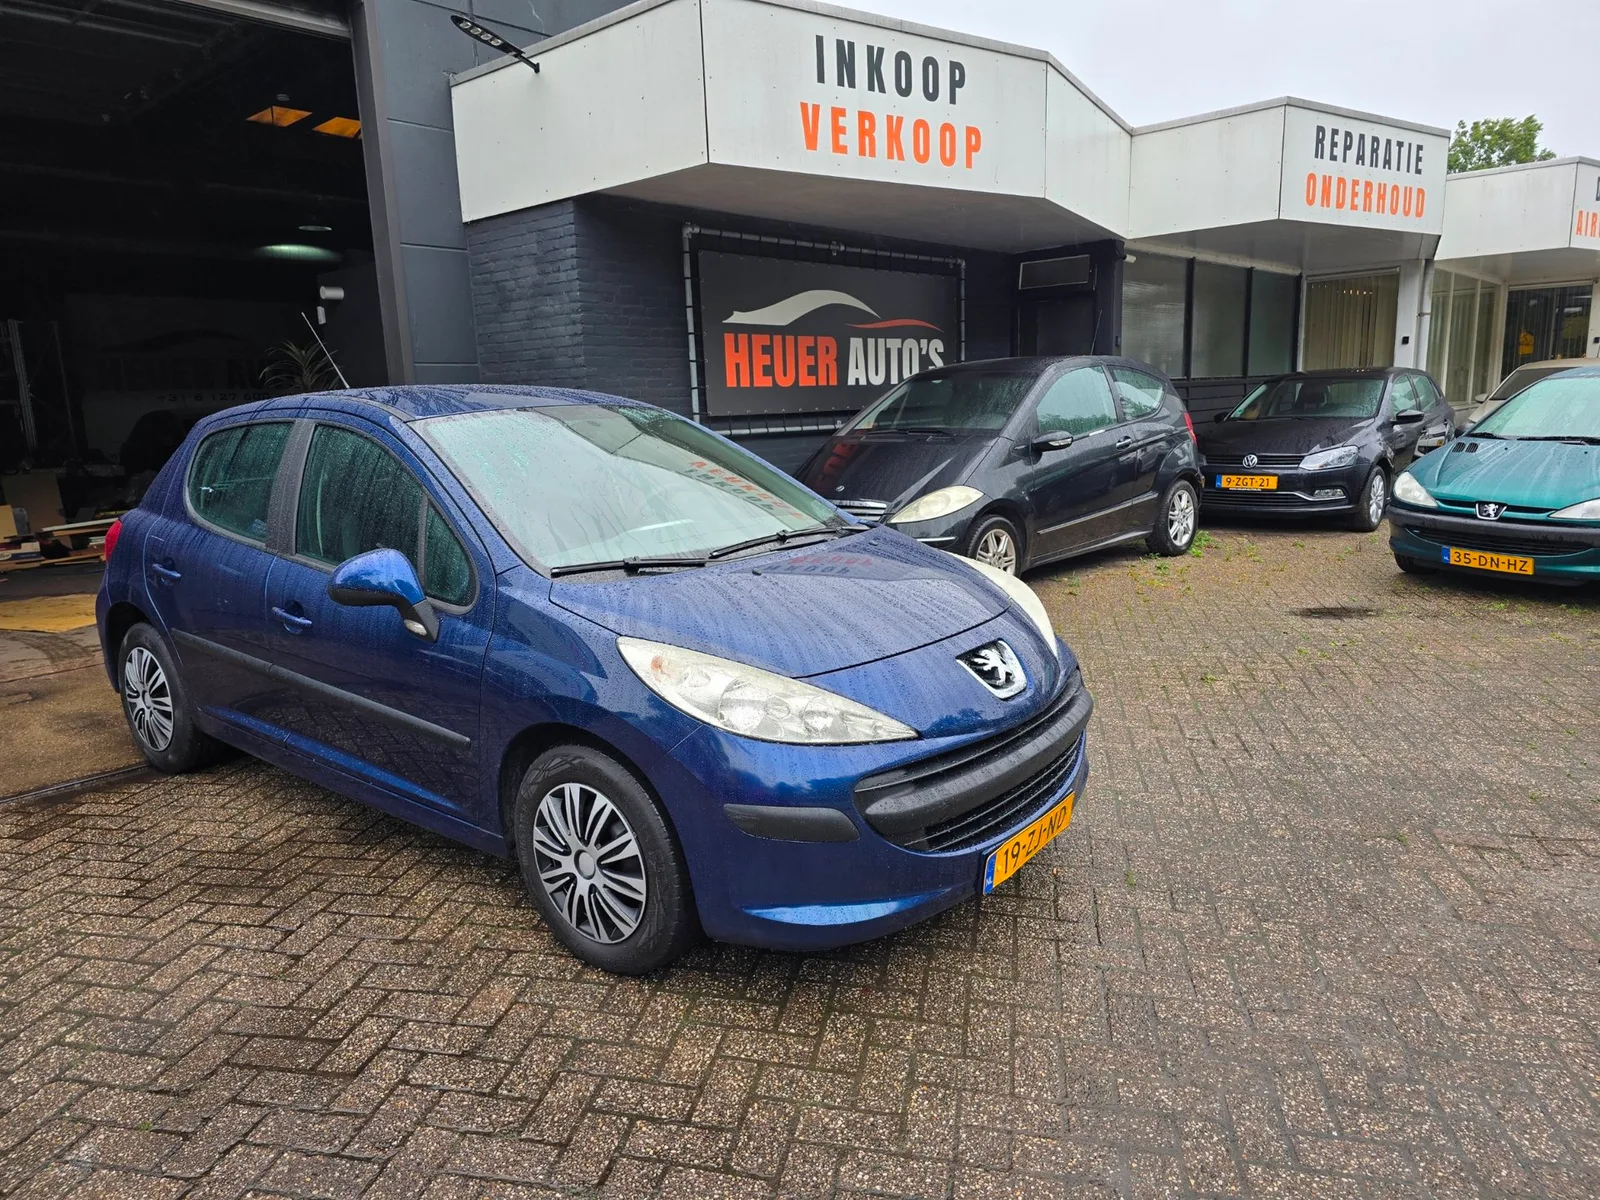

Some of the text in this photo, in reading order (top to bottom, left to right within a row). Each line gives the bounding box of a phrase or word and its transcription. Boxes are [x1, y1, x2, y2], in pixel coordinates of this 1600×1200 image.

[815, 34, 966, 105] INKOOP
[800, 101, 982, 169] VERKOOP
[1314, 125, 1424, 175] REPARATIE
[1305, 172, 1426, 218] ONDERHOUD
[1576, 210, 1600, 238] AIR
[724, 332, 945, 388] HEUER AUTO'S
[1225, 477, 1270, 488] 9-ZGT-21
[1454, 551, 1529, 573] 35-DN-HZ
[1003, 805, 1067, 875] 19-ZJ-ND
